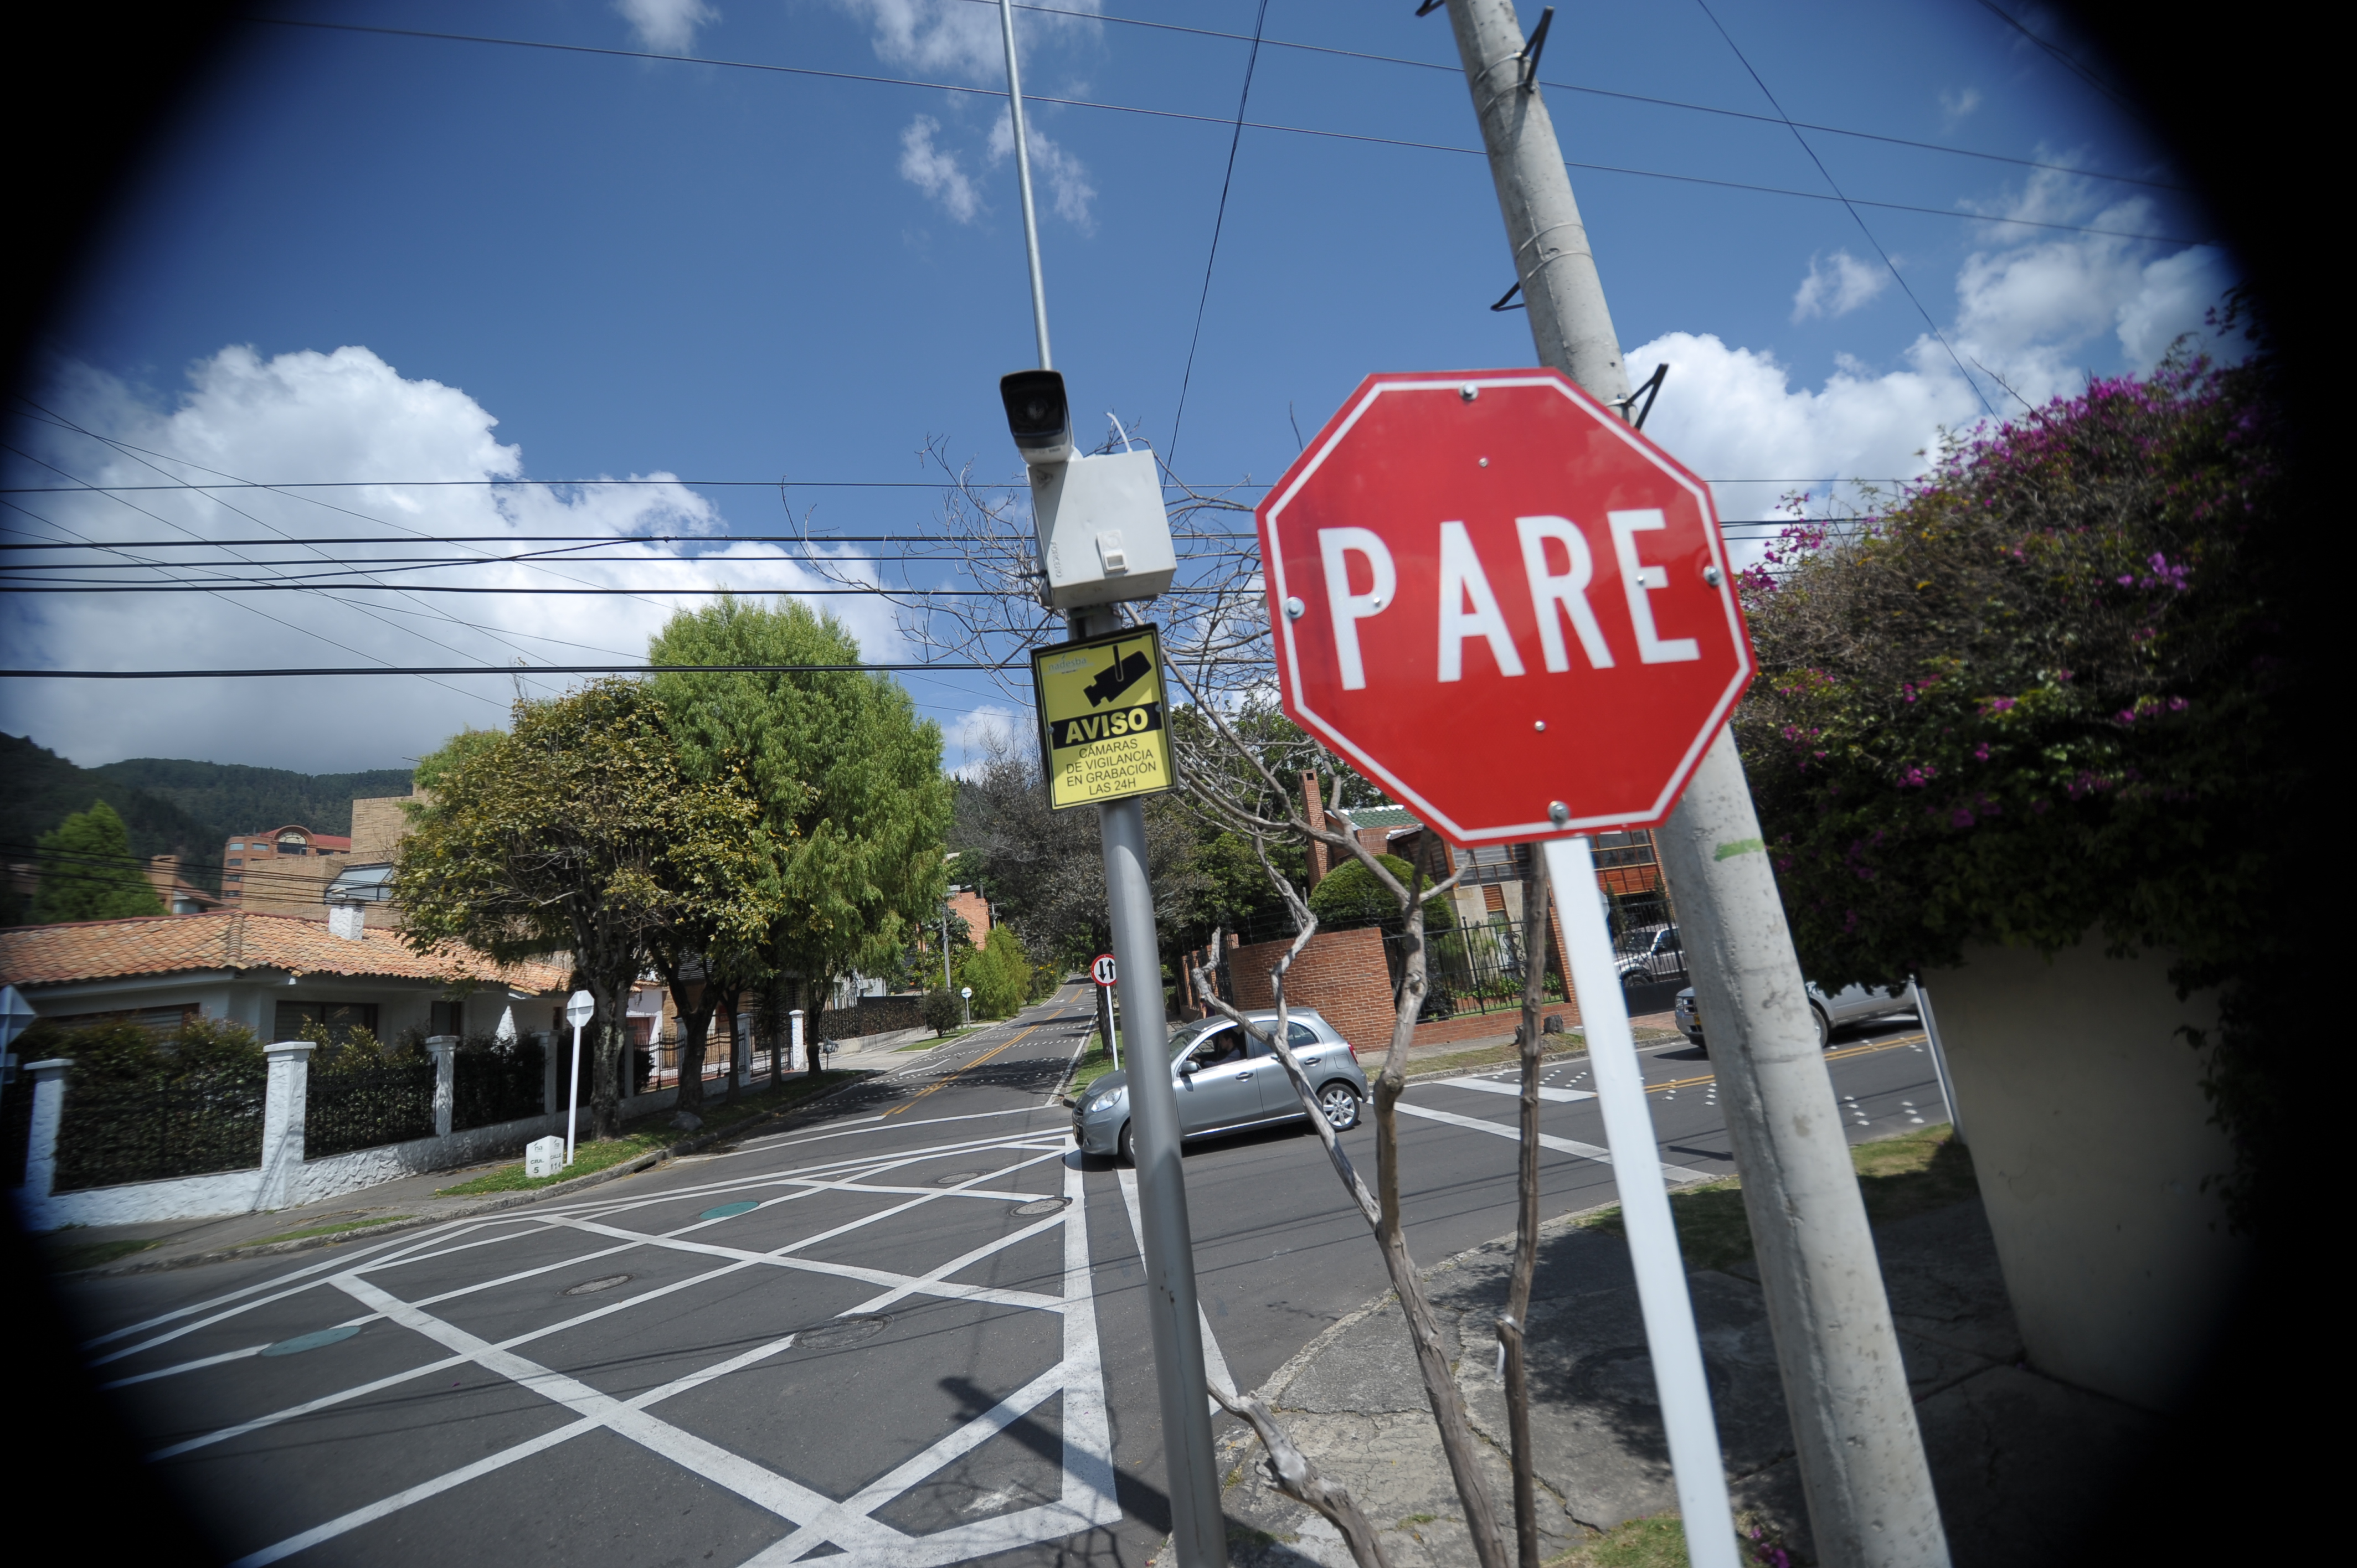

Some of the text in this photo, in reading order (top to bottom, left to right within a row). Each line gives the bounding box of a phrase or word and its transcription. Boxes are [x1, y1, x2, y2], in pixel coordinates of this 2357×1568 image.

[1317, 508, 1701, 690] PARE
[1048, 657, 1087, 670] nadesba
[1066, 708, 1148, 744] AVISO
[1066, 749, 1154, 774] DE VIGILANCIA
[1079, 739, 1138, 759] CÁMARAS
[1067, 761, 1156, 787] EN GRABACIÓN
[1089, 778, 1136, 795] LAS 24H
